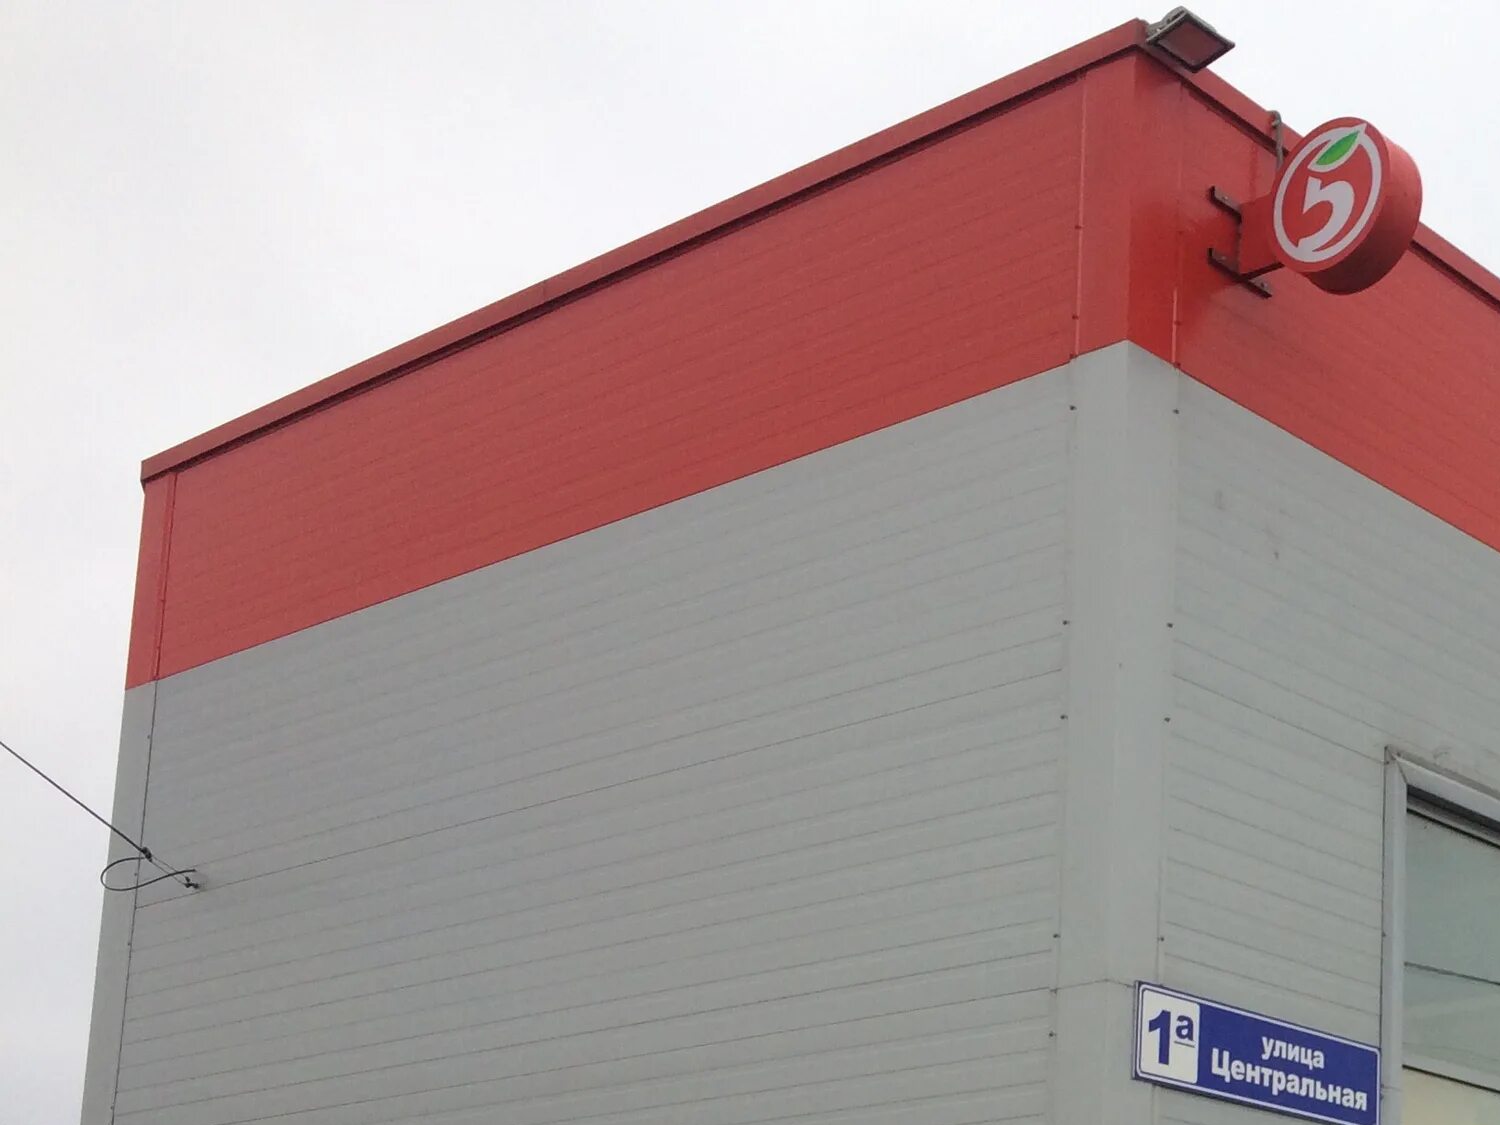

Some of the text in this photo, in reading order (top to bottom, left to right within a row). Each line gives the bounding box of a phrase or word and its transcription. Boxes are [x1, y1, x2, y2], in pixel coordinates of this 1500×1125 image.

[1297, 176, 1356, 252] 5
[1148, 1008, 1195, 1066] 1а
[1261, 1036, 1325, 1070] улица
[1210, 1047, 1368, 1111] Центральная
